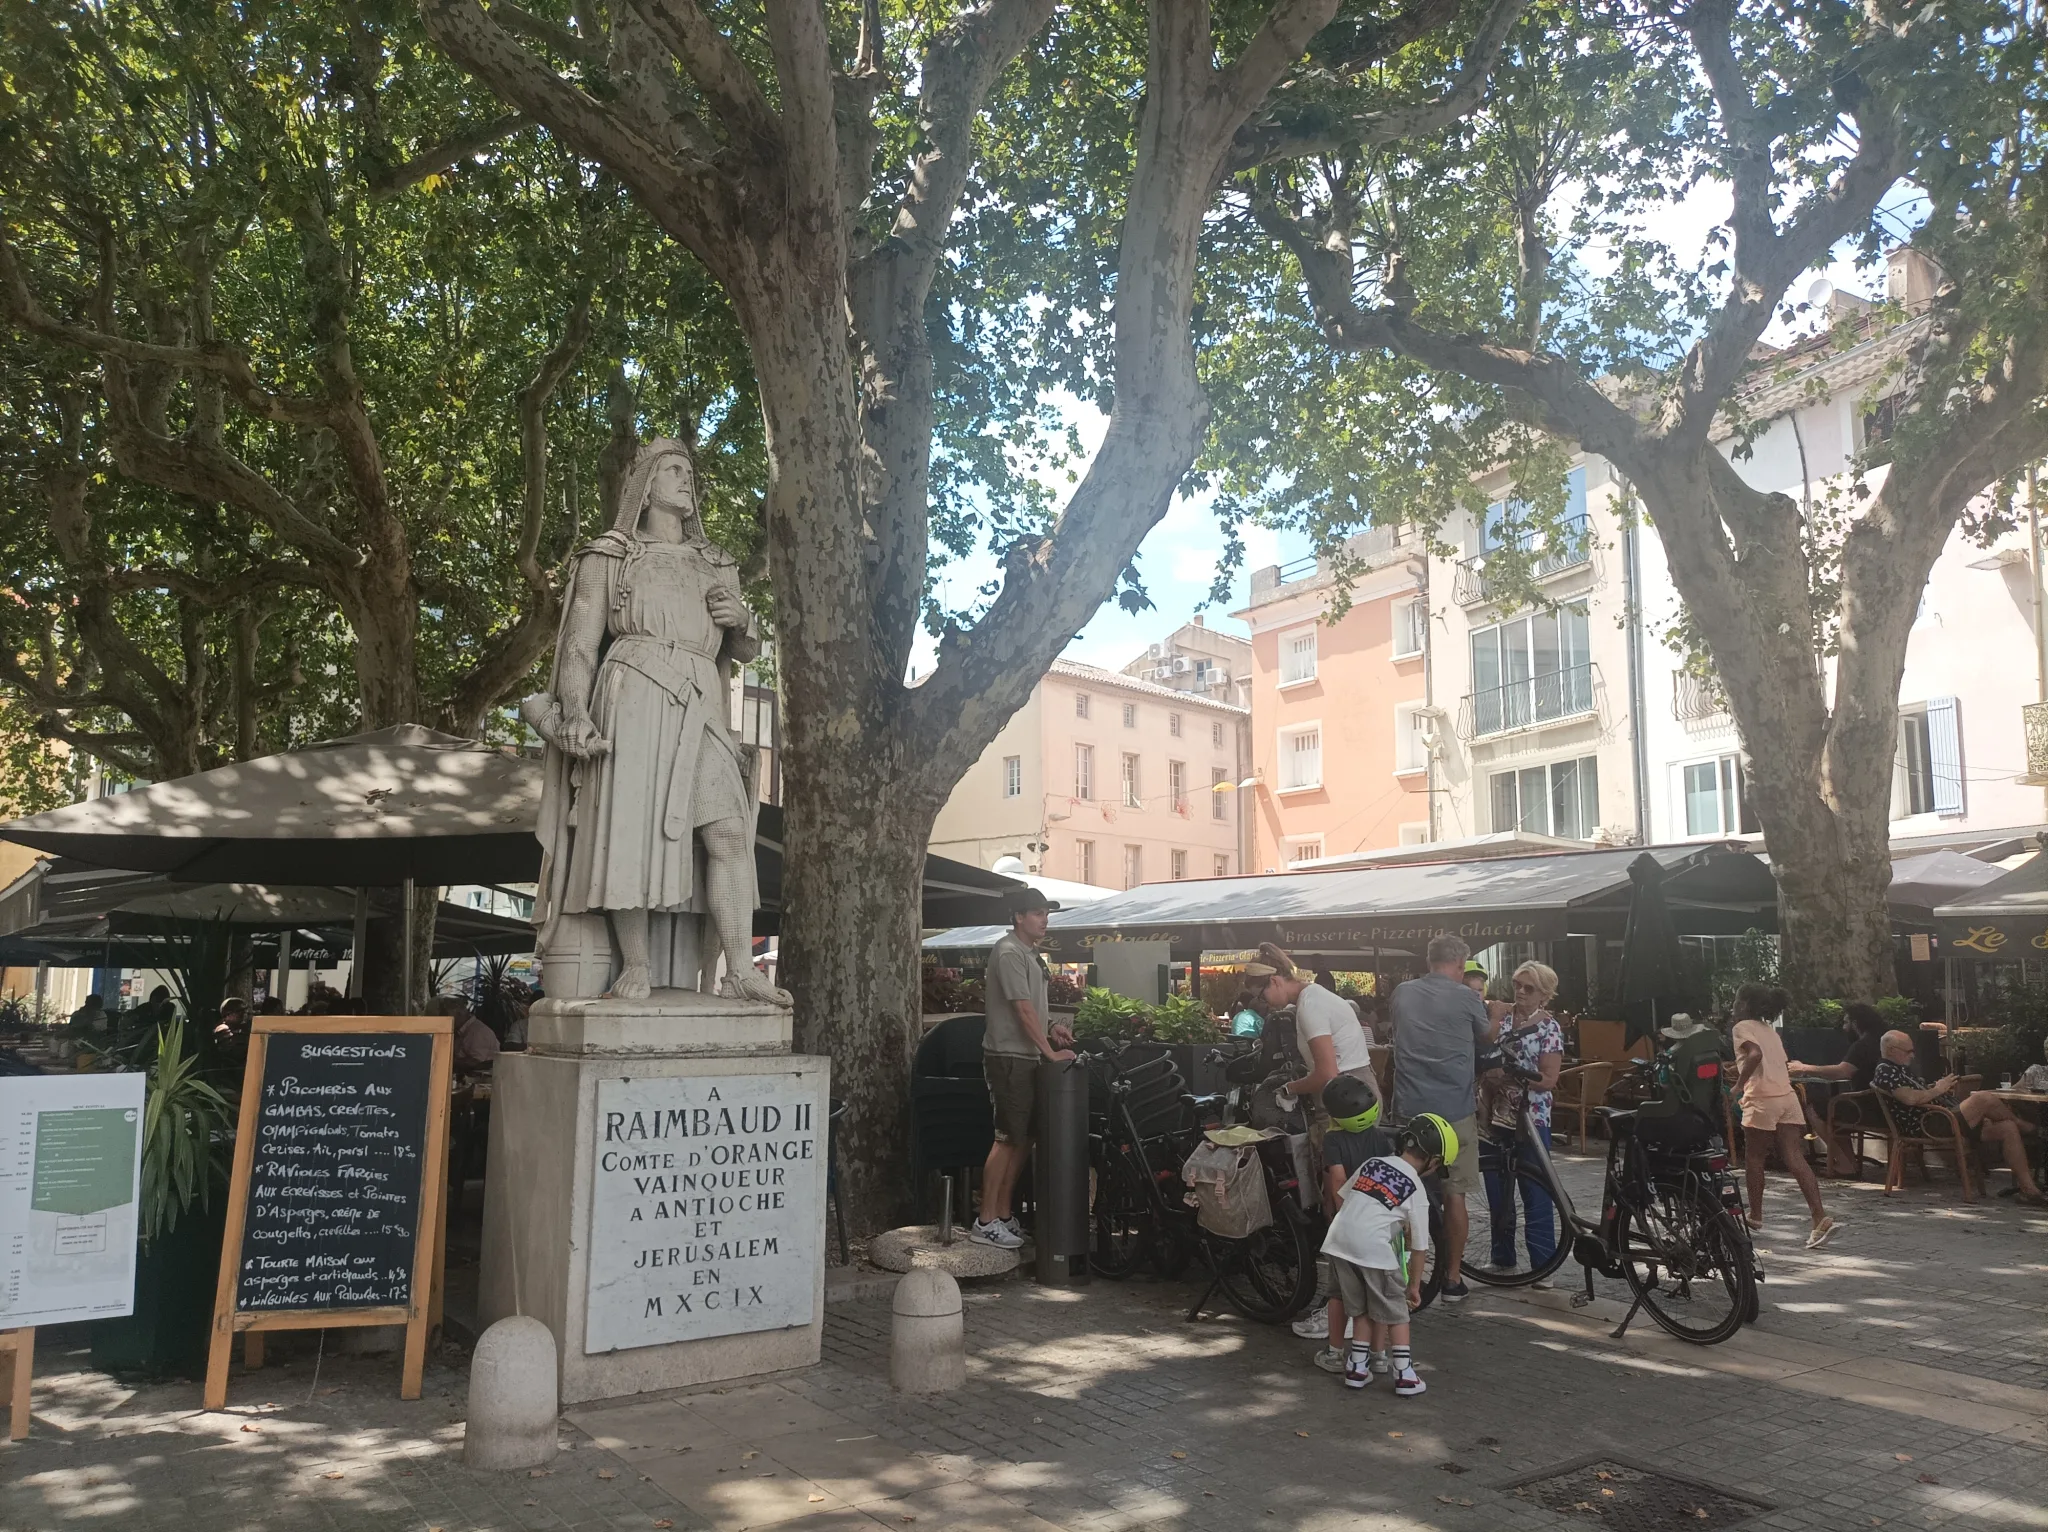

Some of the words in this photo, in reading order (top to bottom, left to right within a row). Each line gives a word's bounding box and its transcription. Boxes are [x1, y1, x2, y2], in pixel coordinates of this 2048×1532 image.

[1953, 926, 2009, 953] Le
[707, 1086, 722, 1101] A
[265, 1104, 326, 1118] GAMBAS,
[604, 1105, 782, 1144] RAIMBAUD
[794, 1103, 812, 1132] II
[601, 1151, 675, 1172] COMTE
[688, 1139, 814, 1168] D'ORANGE
[633, 1167, 786, 1195] VAINQUEUR
[254, 1184, 278, 1199] AUX
[347, 1188, 360, 1199] et
[366, 1210, 381, 1219] DE
[629, 1207, 643, 1222] A
[654, 1191, 786, 1220] ANTIOCHE
[694, 1220, 723, 1238] ET
[353, 1257, 376, 1265] aux
[633, 1237, 780, 1269] JERUSALEM
[243, 1272, 300, 1291] asperges
[303, 1271, 317, 1282] et
[692, 1268, 721, 1285] EN
[313, 1290, 332, 1302] AUX
[334, 1284, 381, 1301] Palourdes
